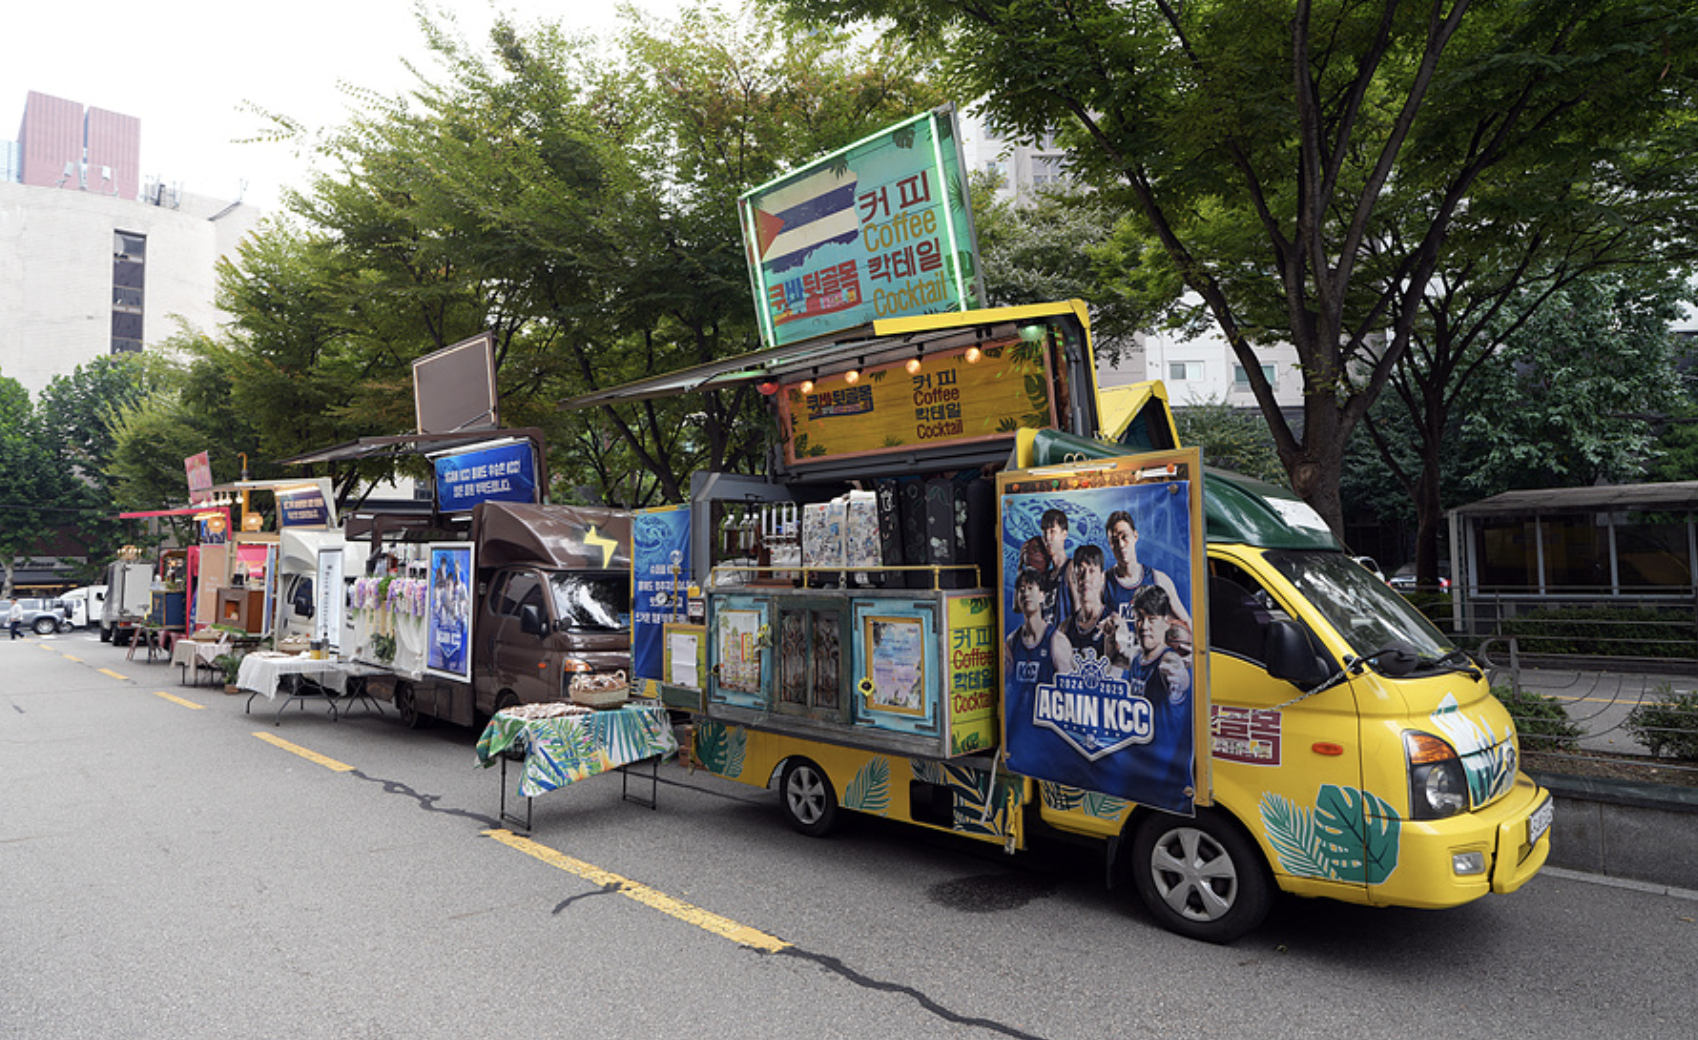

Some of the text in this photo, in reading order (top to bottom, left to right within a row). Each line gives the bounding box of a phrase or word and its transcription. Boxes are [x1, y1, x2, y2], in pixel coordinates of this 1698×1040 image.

[863, 208, 937, 252] Coffee
[867, 237, 943, 283] 칵테일
[873, 270, 949, 317] Cocktail
[913, 387, 960, 407] Coffee
[915, 401, 962, 422] 칵테일
[916, 418, 964, 439] Cocktail
[953, 647, 994, 670] Coffee
[953, 668, 994, 692] 칵테일
[1060, 677, 1084, 691] 2024
[1100, 680, 1125, 695] 2025
[954, 688, 995, 714] Cocktail
[1038, 688, 1149, 735] AGAIN KCC
